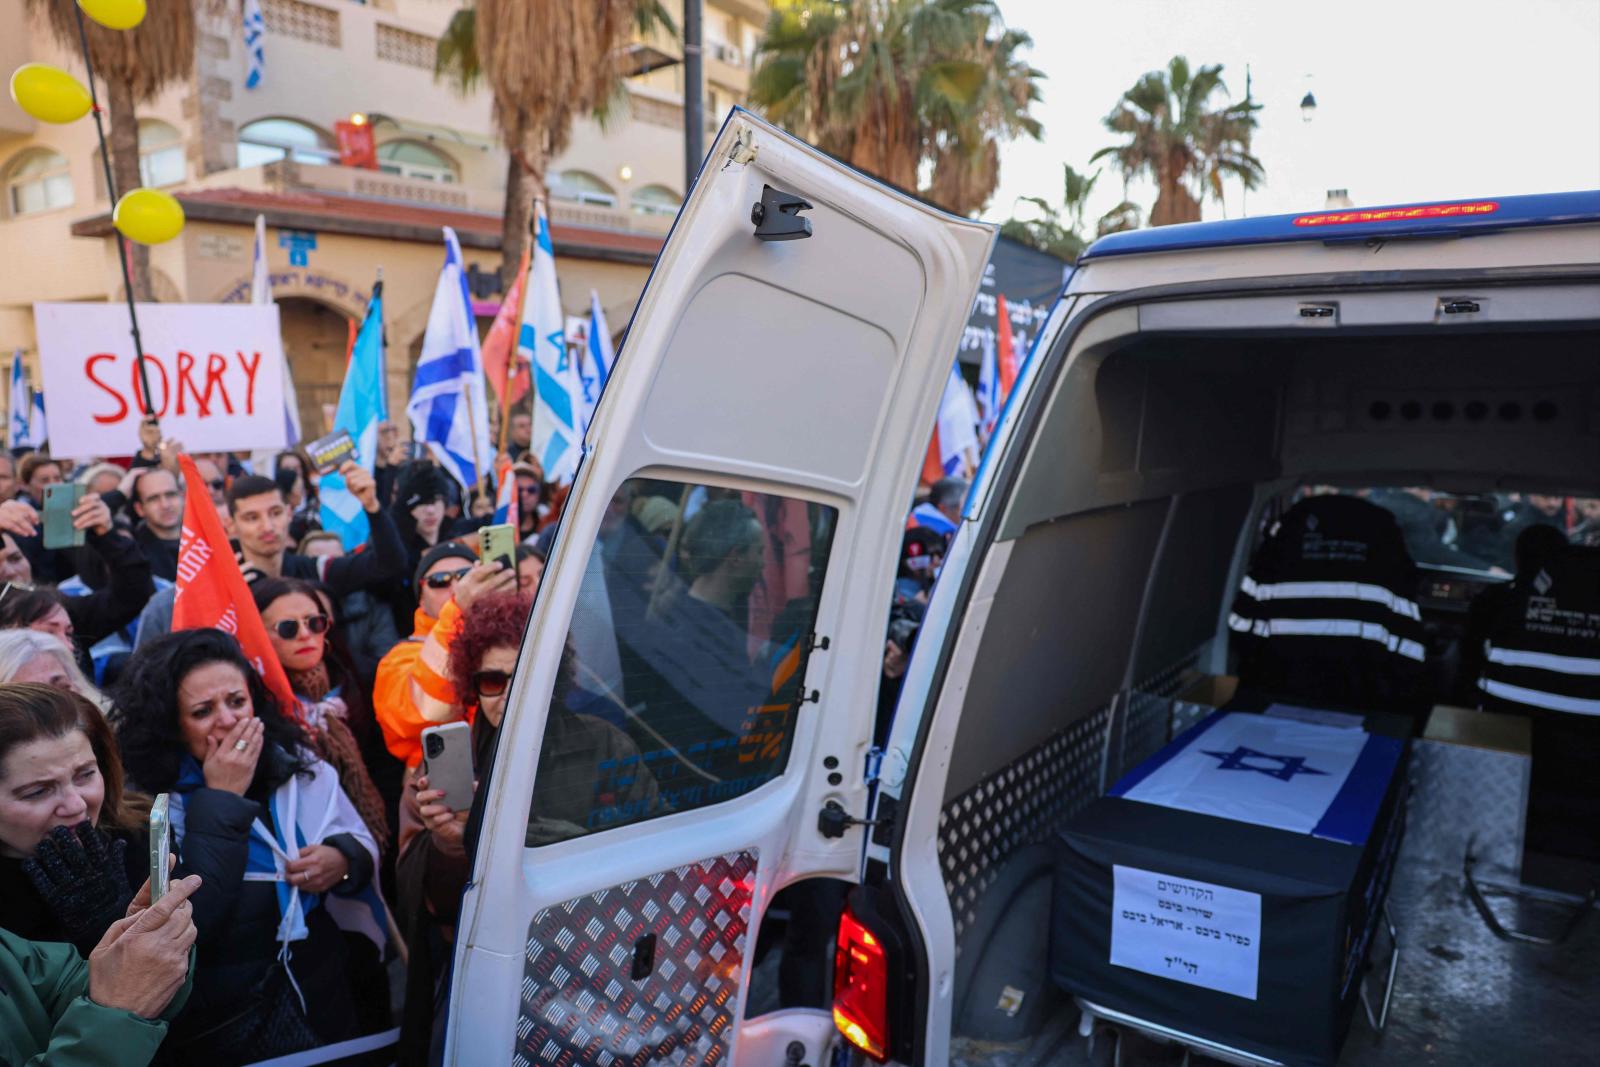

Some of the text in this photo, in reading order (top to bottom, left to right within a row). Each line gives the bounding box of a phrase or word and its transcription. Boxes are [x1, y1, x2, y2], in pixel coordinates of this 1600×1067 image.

[85, 352, 261, 424] SORRY
[1157, 880, 1214, 901] הקדושים
[1122, 910, 1147, 923] ביבס
[1158, 899, 1213, 919] שירי ביבס
[1151, 913, 1183, 931] אריאל
[1195, 925, 1221, 940] ביבס
[1225, 931, 1251, 946] כפיר
